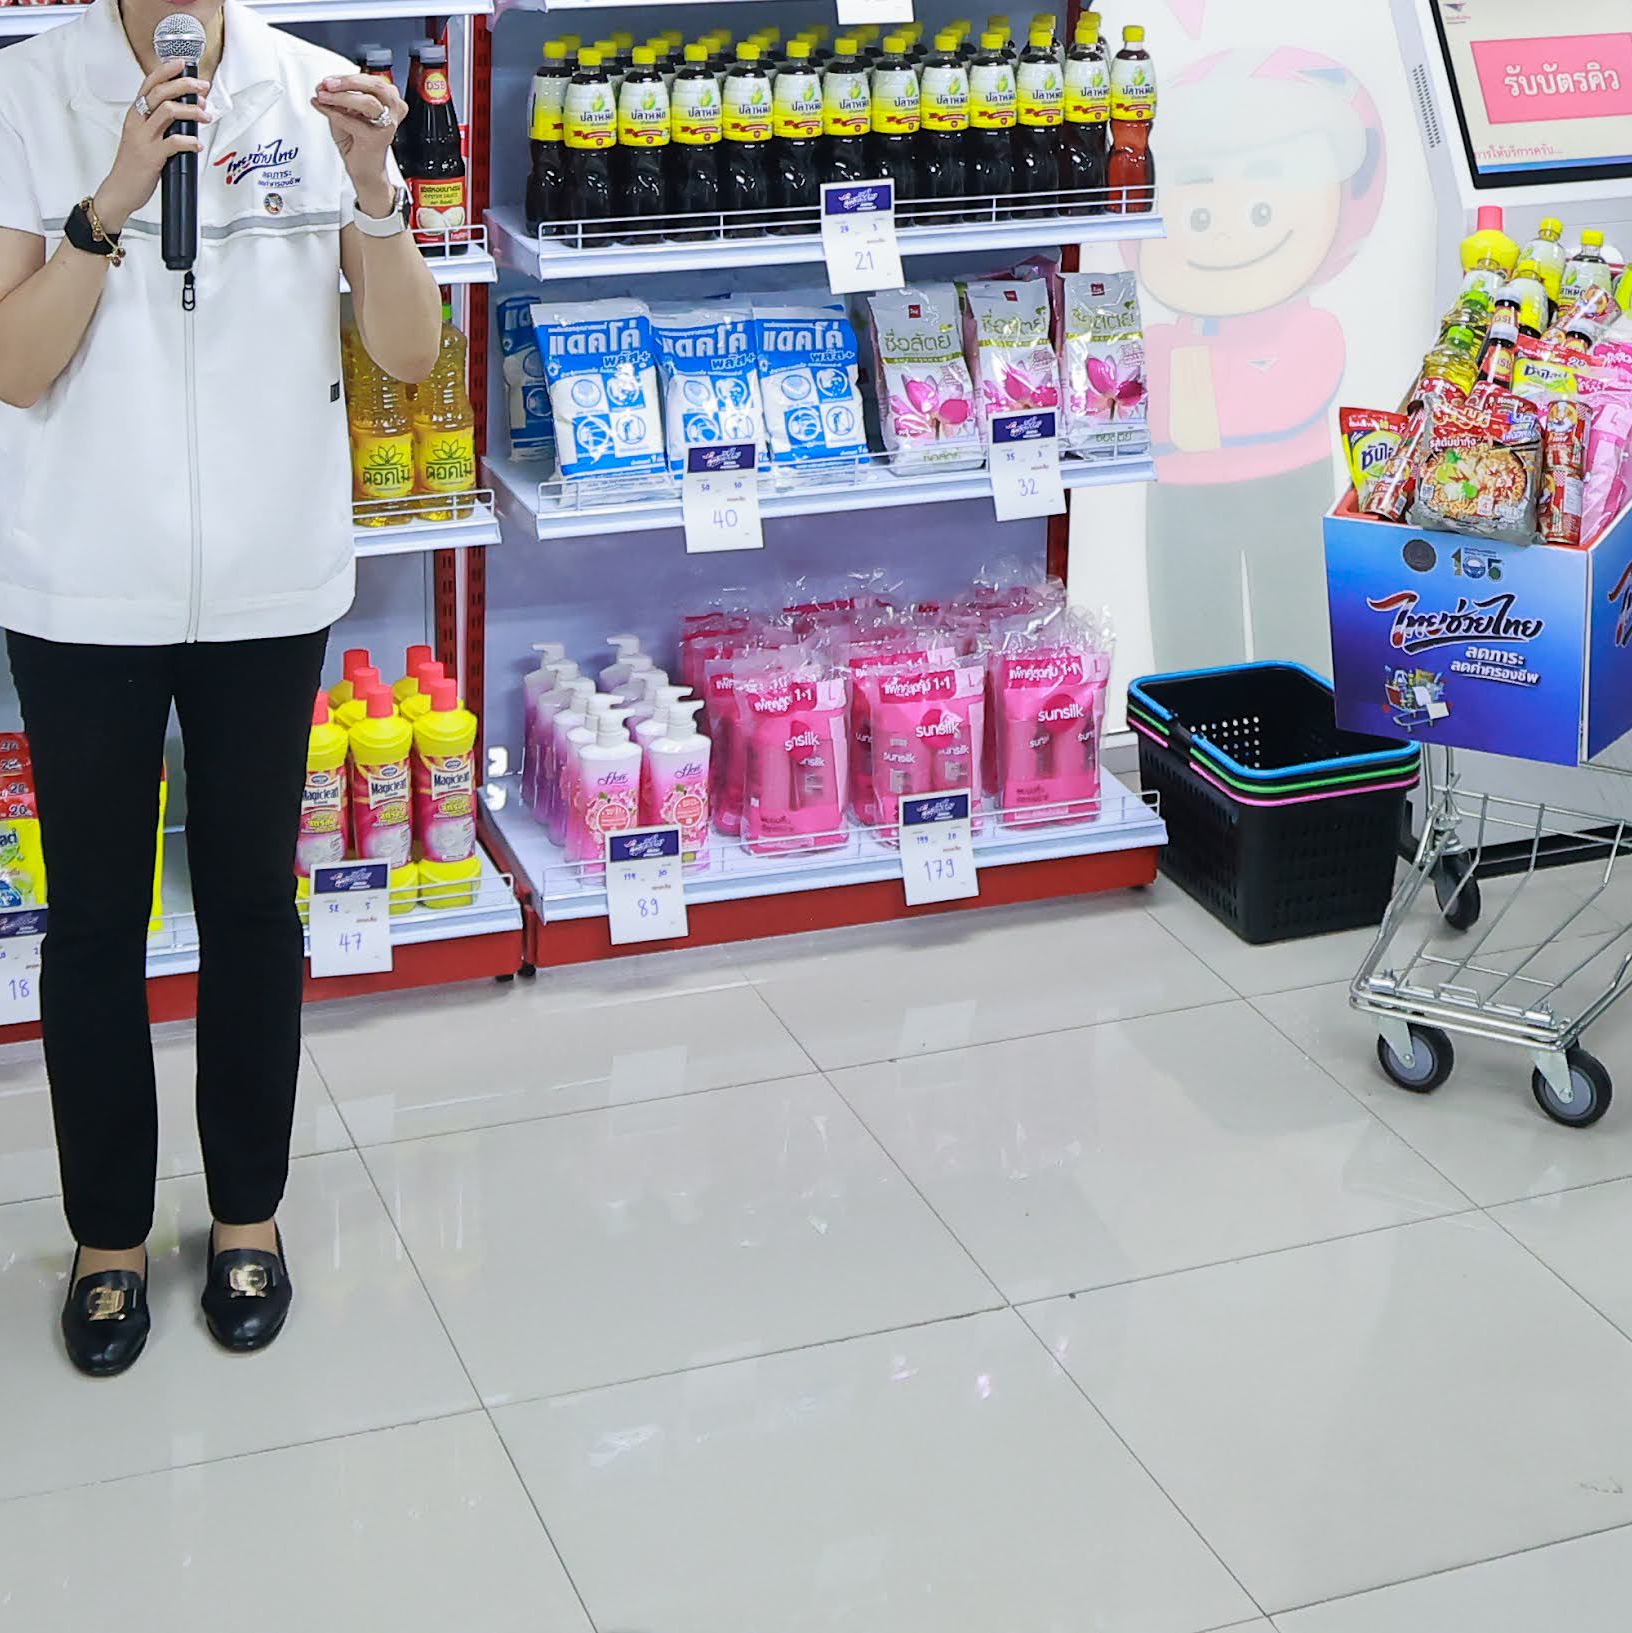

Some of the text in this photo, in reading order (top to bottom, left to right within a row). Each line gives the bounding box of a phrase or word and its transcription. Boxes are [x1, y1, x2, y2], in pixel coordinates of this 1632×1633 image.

[1503, 61, 1621, 97] รับบัตรคิว
[854, 250, 875, 271] 21
[1018, 478, 1039, 497] 32
[712, 509, 738, 529] 40
[1367, 590, 1546, 656] ไทยช่วยไทย
[1465, 645, 1525, 665] ลดภาระ
[1450, 659, 1541, 684] ลดค่าครองชีพ
[1038, 703, 1085, 723] sunsilk
[915, 718, 961, 738] sunsilk
[784, 730, 820, 752] snsilk
[371, 778, 407, 795] Magiclean
[433, 770, 470, 787] Magiclean
[10, 804, 28, 816] 20
[922, 857, 956, 882] 179
[637, 898, 659, 918] 89
[339, 932, 362, 953] 47
[8, 978, 30, 1001] 18
